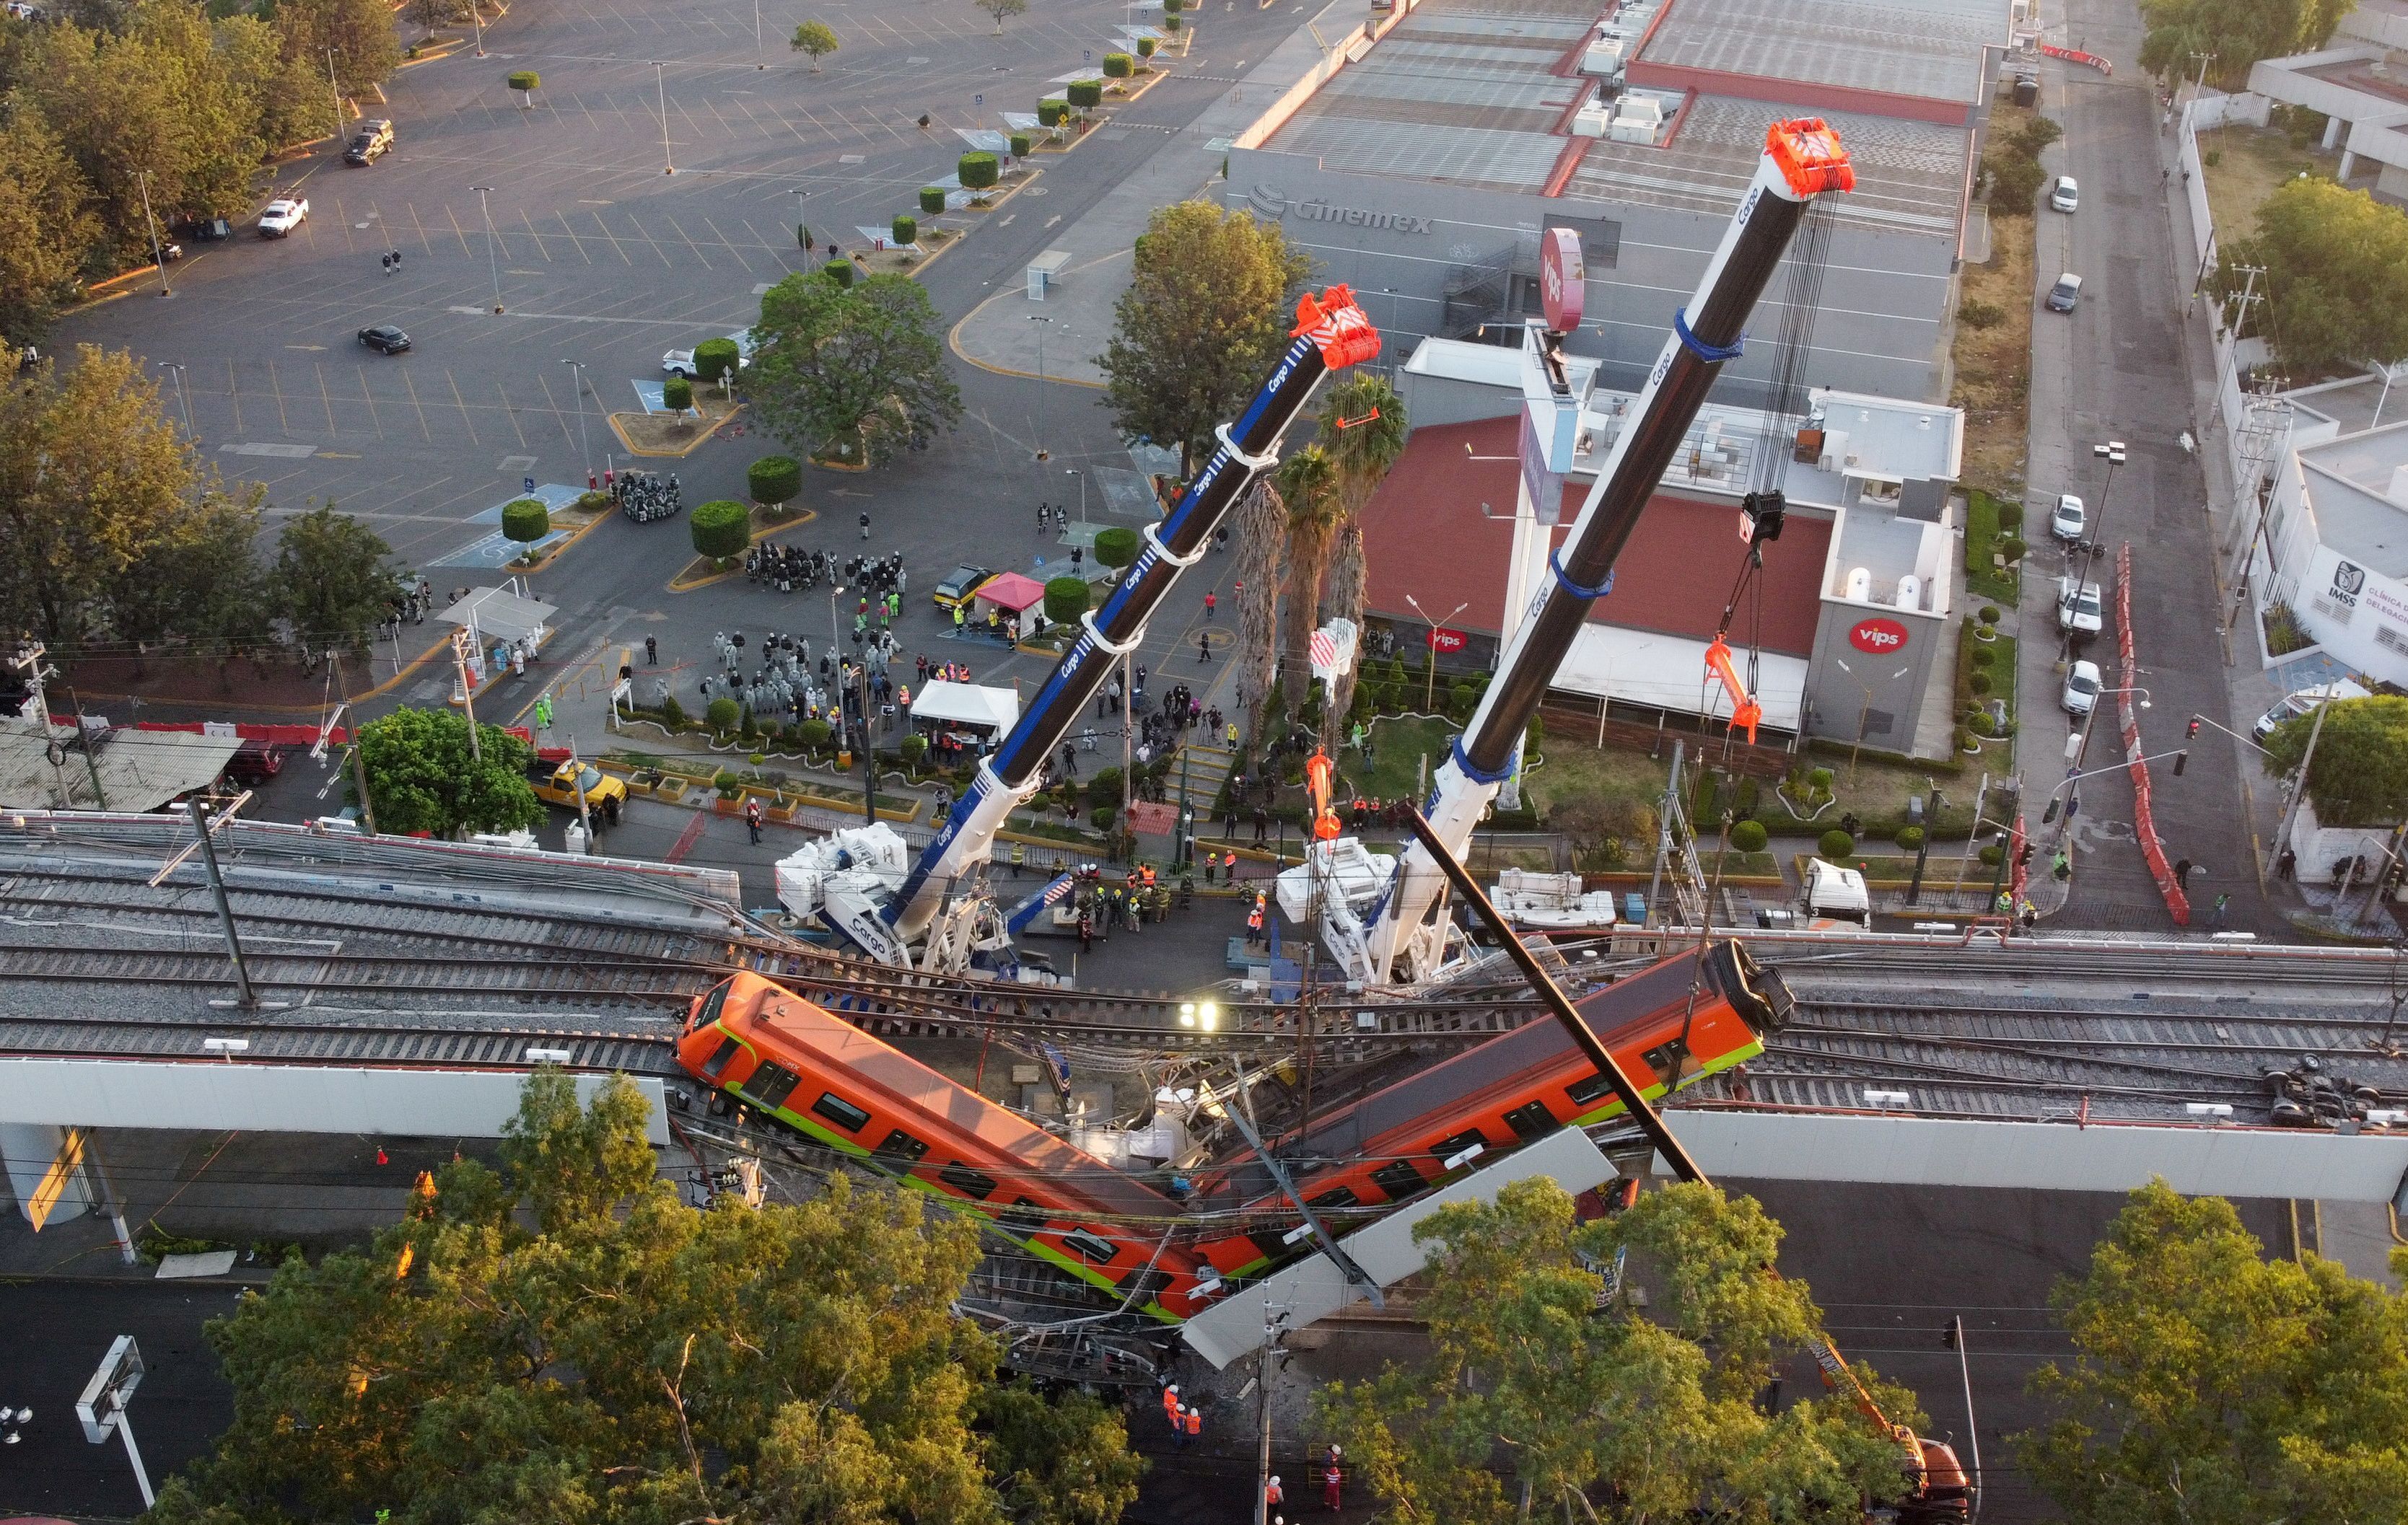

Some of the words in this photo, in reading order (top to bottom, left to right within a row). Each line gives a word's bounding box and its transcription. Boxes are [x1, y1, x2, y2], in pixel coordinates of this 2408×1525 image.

[1295, 197, 1433, 234] Cinemex
[1738, 188, 1758, 225] Cargo
[1545, 255, 1561, 302] vips
[1269, 365, 1287, 392] Cargo
[1652, 353, 1671, 386] Cargo
[1194, 472, 1212, 496] Cargo
[1126, 568, 1141, 589] Cargo
[1532, 587, 1548, 618] Cargo
[2329, 587, 2357, 607] IMSS
[1432, 633, 1460, 646] vips
[1860, 628, 1899, 646] vips
[937, 825, 953, 846] Cargo
[853, 918, 885, 954] Cargo
